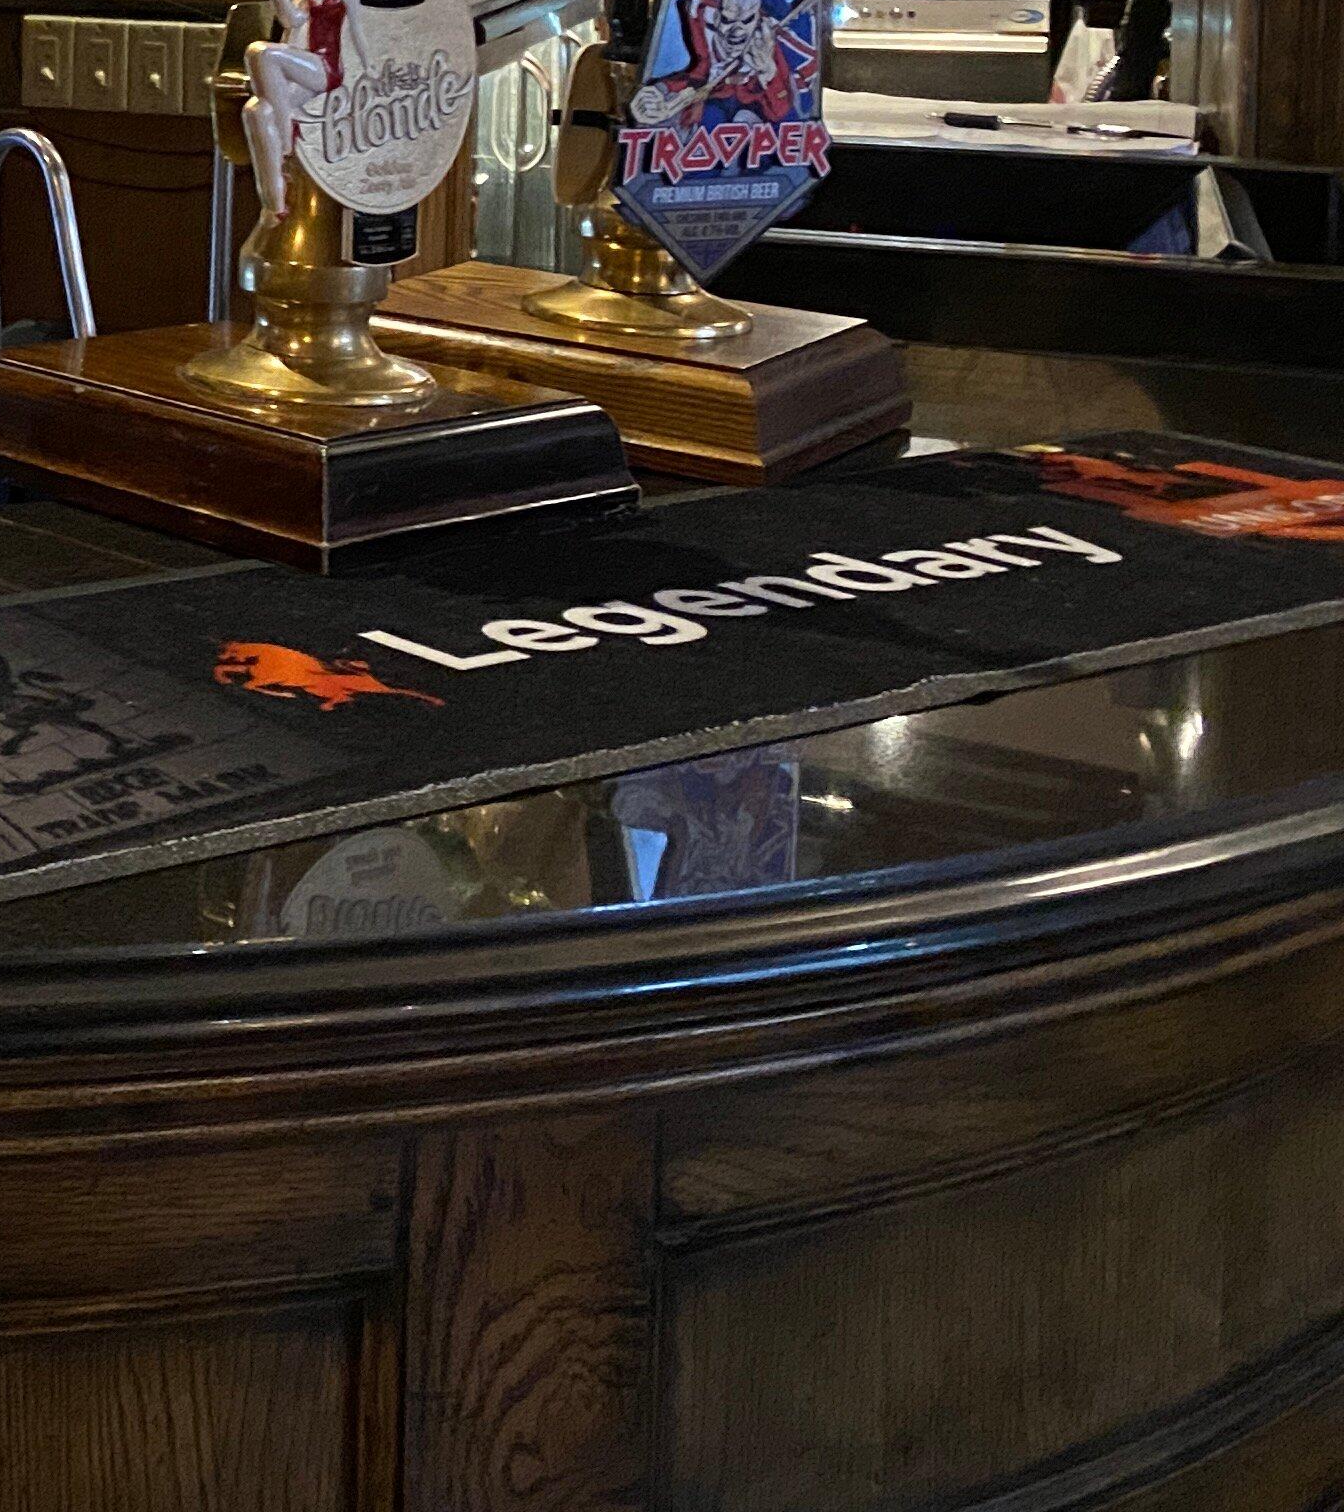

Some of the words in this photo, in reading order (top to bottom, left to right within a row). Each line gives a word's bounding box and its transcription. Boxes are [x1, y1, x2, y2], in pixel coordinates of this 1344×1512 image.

[618, 121, 832, 186] TROOPER
[750, 182, 780, 200] BEER
[358, 524, 1124, 671] Legendary
